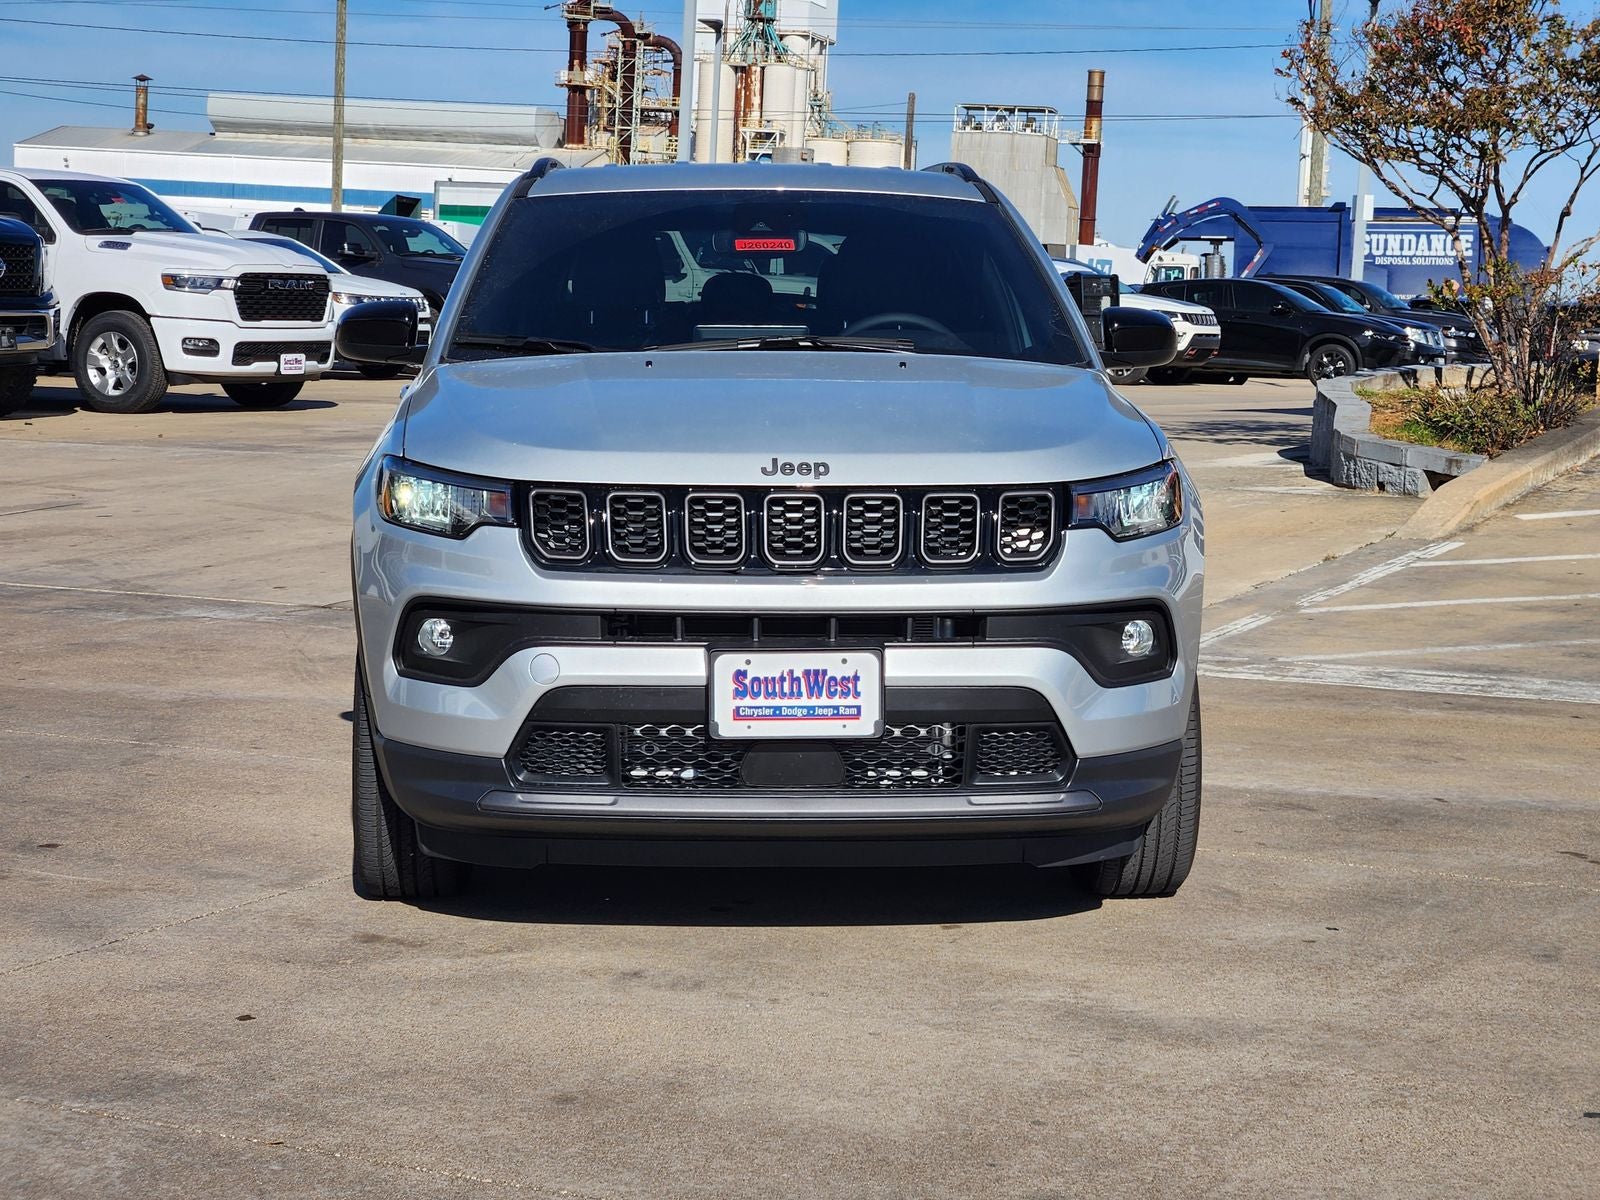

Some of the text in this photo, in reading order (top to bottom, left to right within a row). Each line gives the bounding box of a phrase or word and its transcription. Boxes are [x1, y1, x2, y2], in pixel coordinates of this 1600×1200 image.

[741, 241, 791, 249] J260240
[1375, 256, 1455, 265] DISPOSAL SOLUTIONS
[760, 457, 830, 480] Jeep
[732, 668, 862, 700] SouthWest
[739, 705, 858, 717] Chrysler Dodge Jeep Ram
